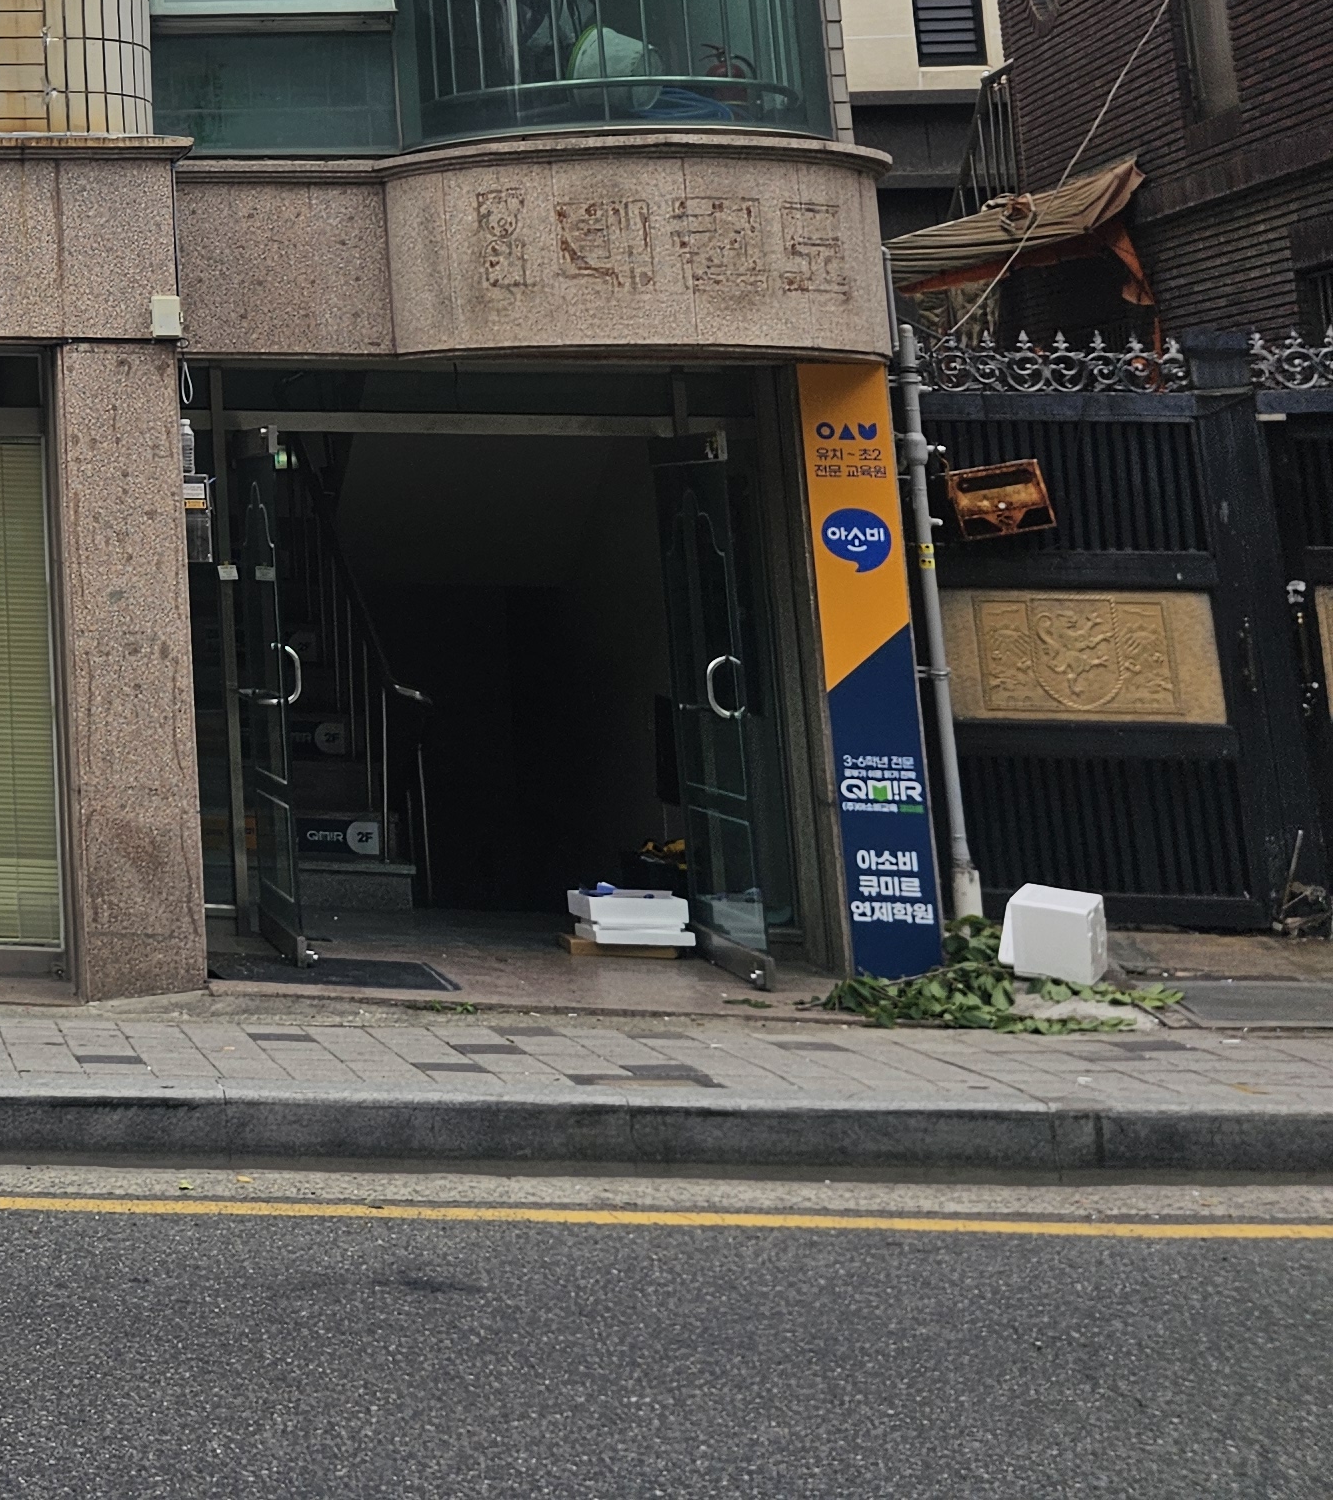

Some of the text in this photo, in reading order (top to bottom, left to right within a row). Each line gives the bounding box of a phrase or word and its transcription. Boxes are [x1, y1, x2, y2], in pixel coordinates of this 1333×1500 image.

[816, 448, 843, 461] 유치
[859, 448, 882, 461] 초2
[814, 465, 887, 478] 전문 교육원
[827, 527, 885, 552] 아소비
[891, 756, 914, 769] 전문
[357, 832, 373, 842] 2F
[857, 850, 918, 872] 아소비
[859, 876, 922, 897] 큐미르
[851, 901, 934, 924] 연제학원
